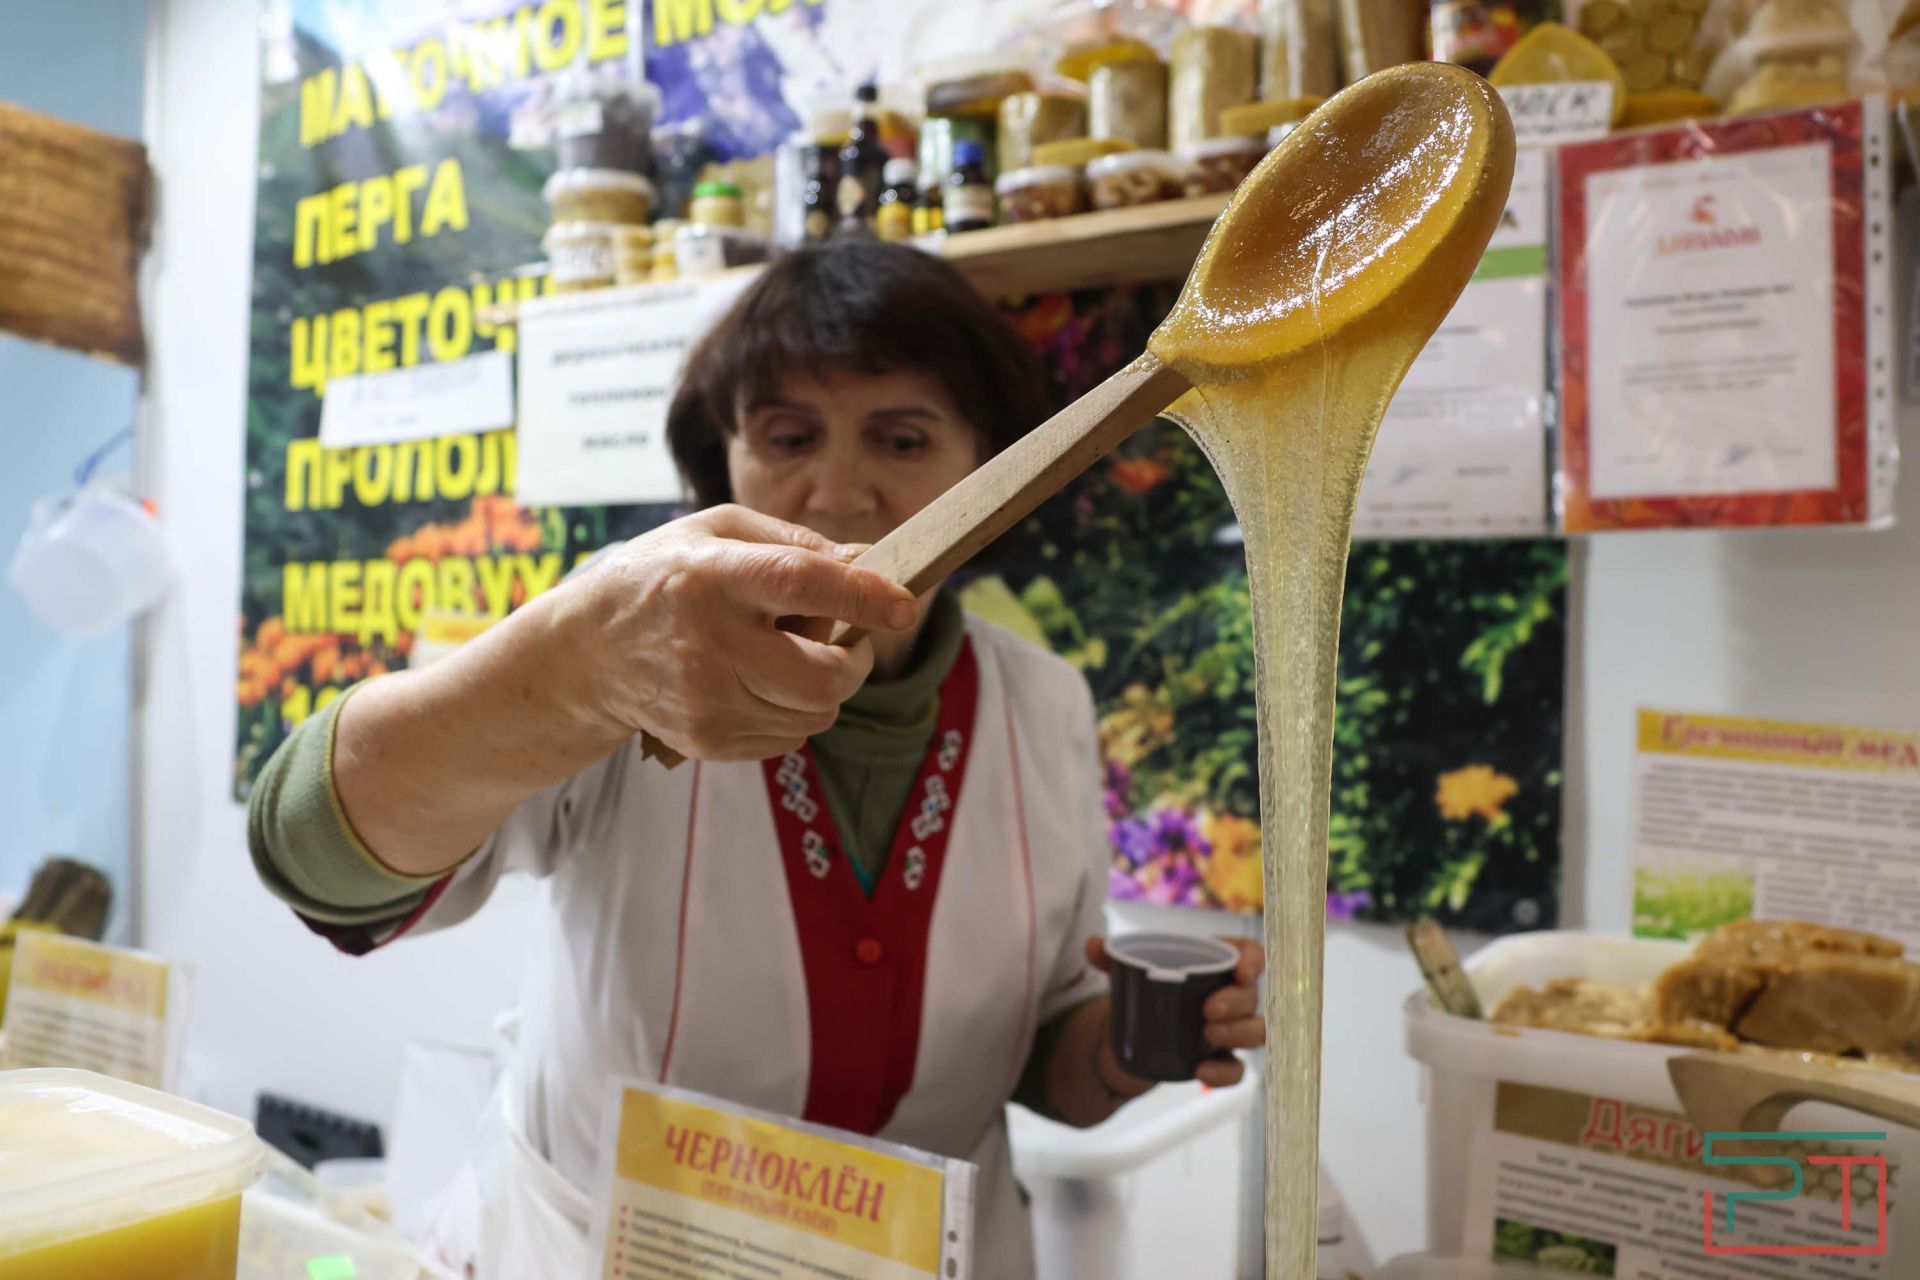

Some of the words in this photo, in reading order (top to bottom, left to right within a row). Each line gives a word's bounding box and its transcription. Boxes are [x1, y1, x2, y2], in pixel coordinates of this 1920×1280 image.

[293, 158, 468, 268] ПЕРГА
[283, 551, 593, 648] МЕДОВУХ
[664, 1123, 886, 1223] ЧЕРНОКЛЁН
